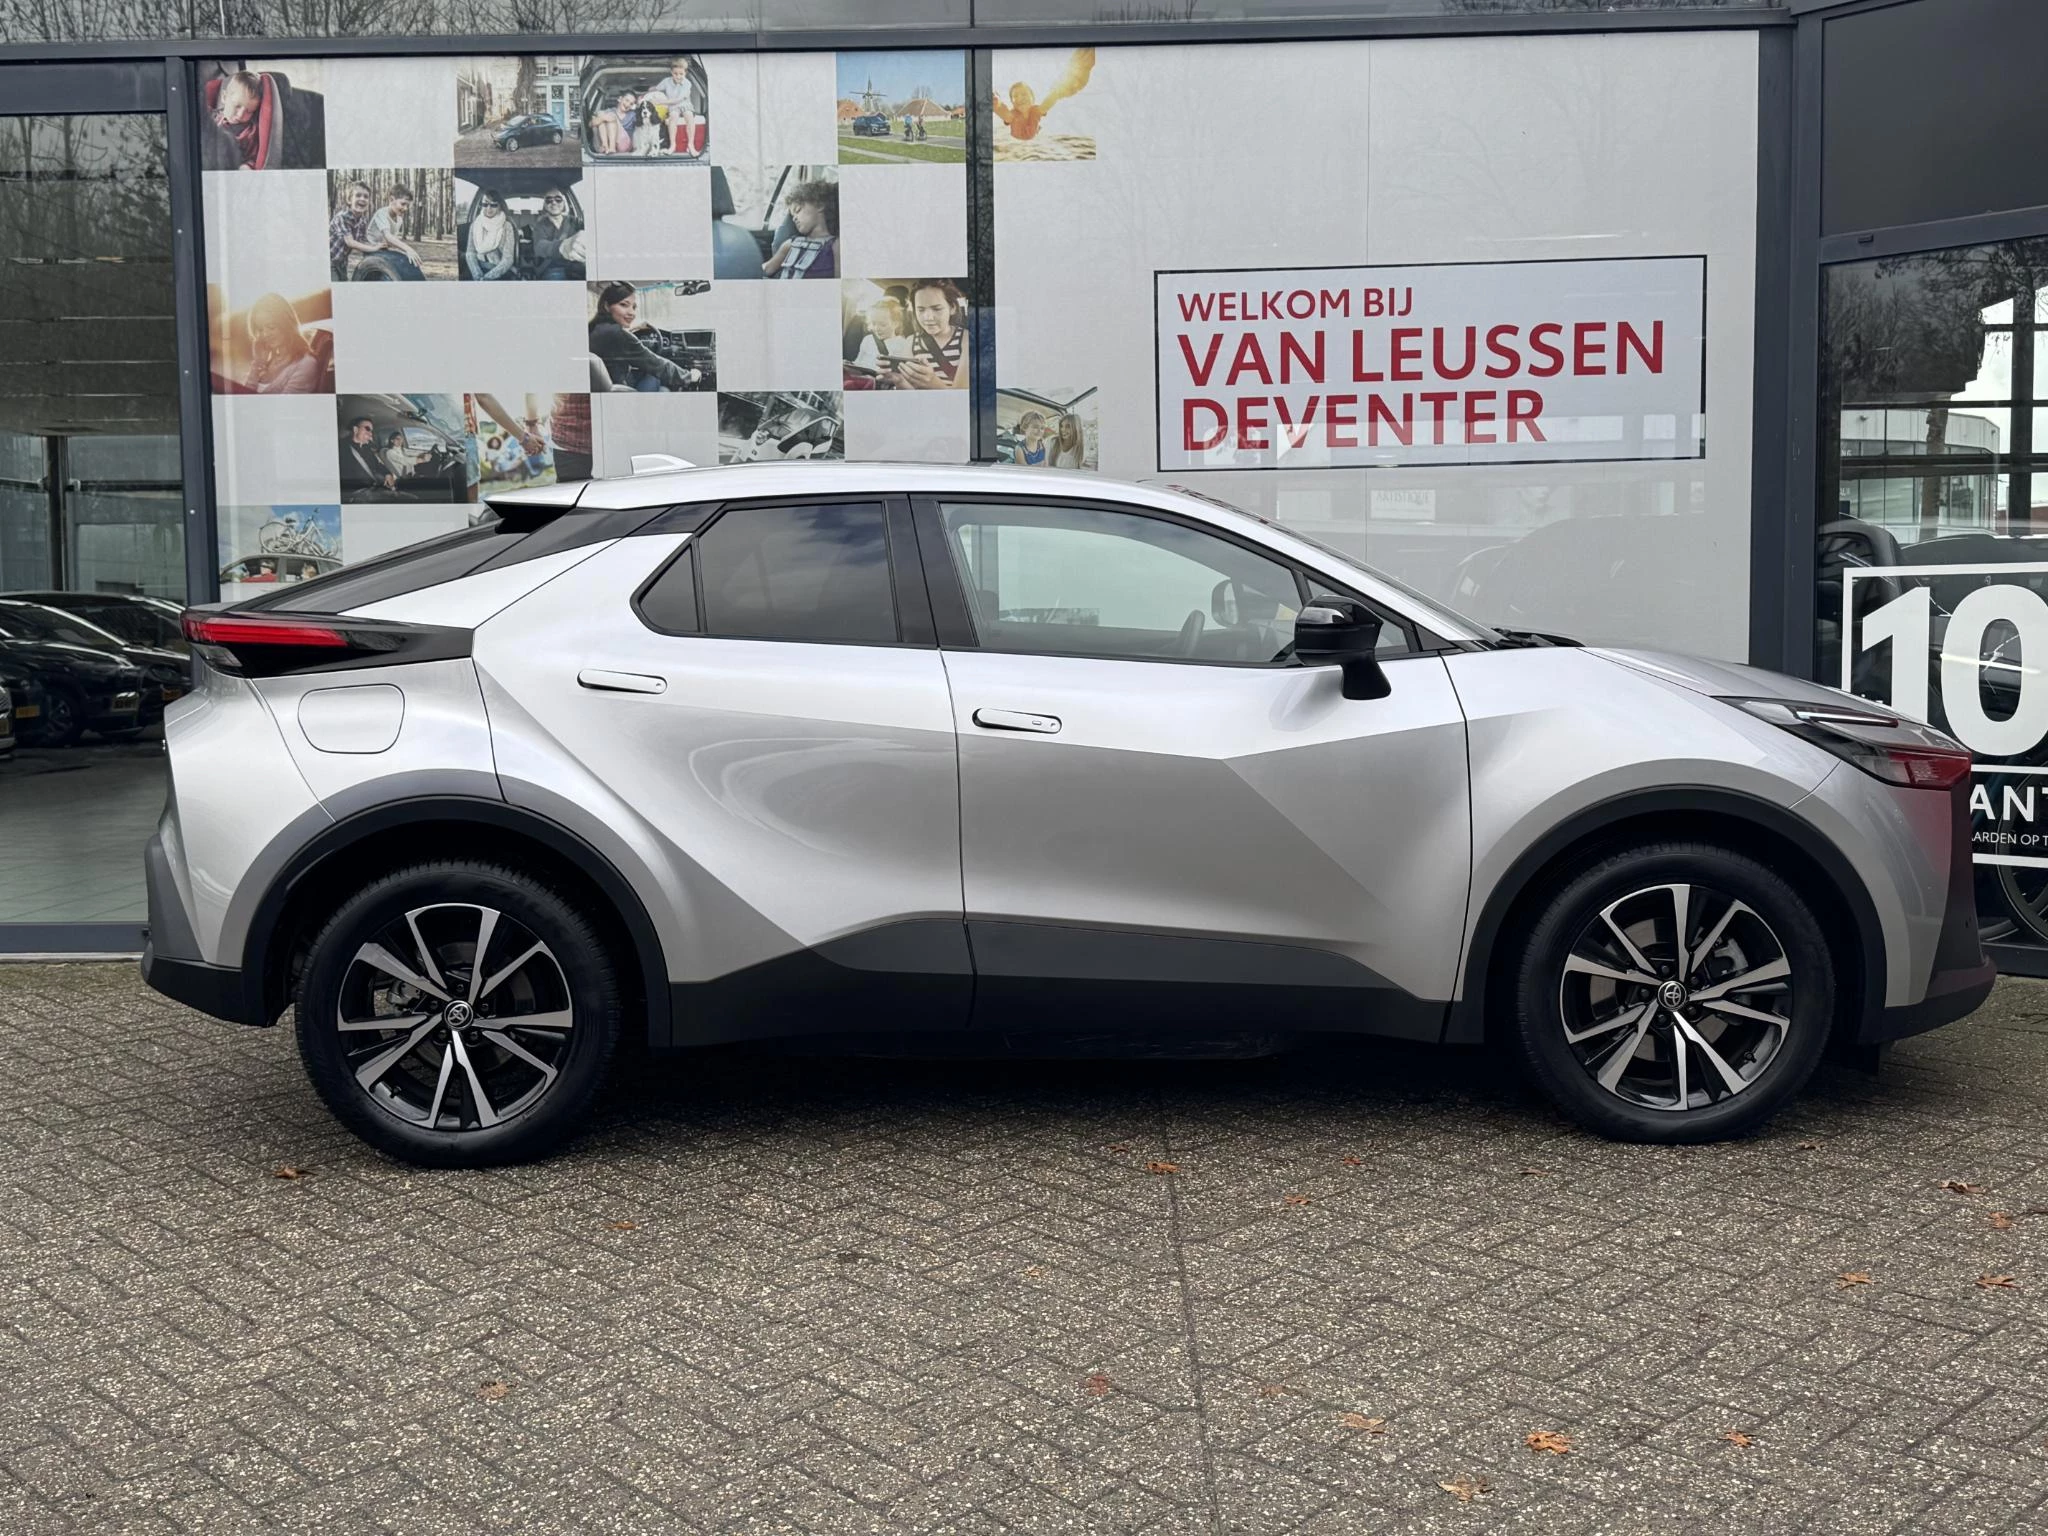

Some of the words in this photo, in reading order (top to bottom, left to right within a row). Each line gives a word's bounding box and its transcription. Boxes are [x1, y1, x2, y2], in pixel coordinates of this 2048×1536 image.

[1177, 288, 1351, 322] WELKOM
[1363, 287, 1413, 319] BIJ
[1177, 330, 1326, 388] VAN
[1351, 320, 1664, 384] LEUSSEN
[1182, 388, 1547, 452] DEVENTER
[1971, 831, 2017, 844] ARDEN
[2020, 833, 2040, 846] OP
